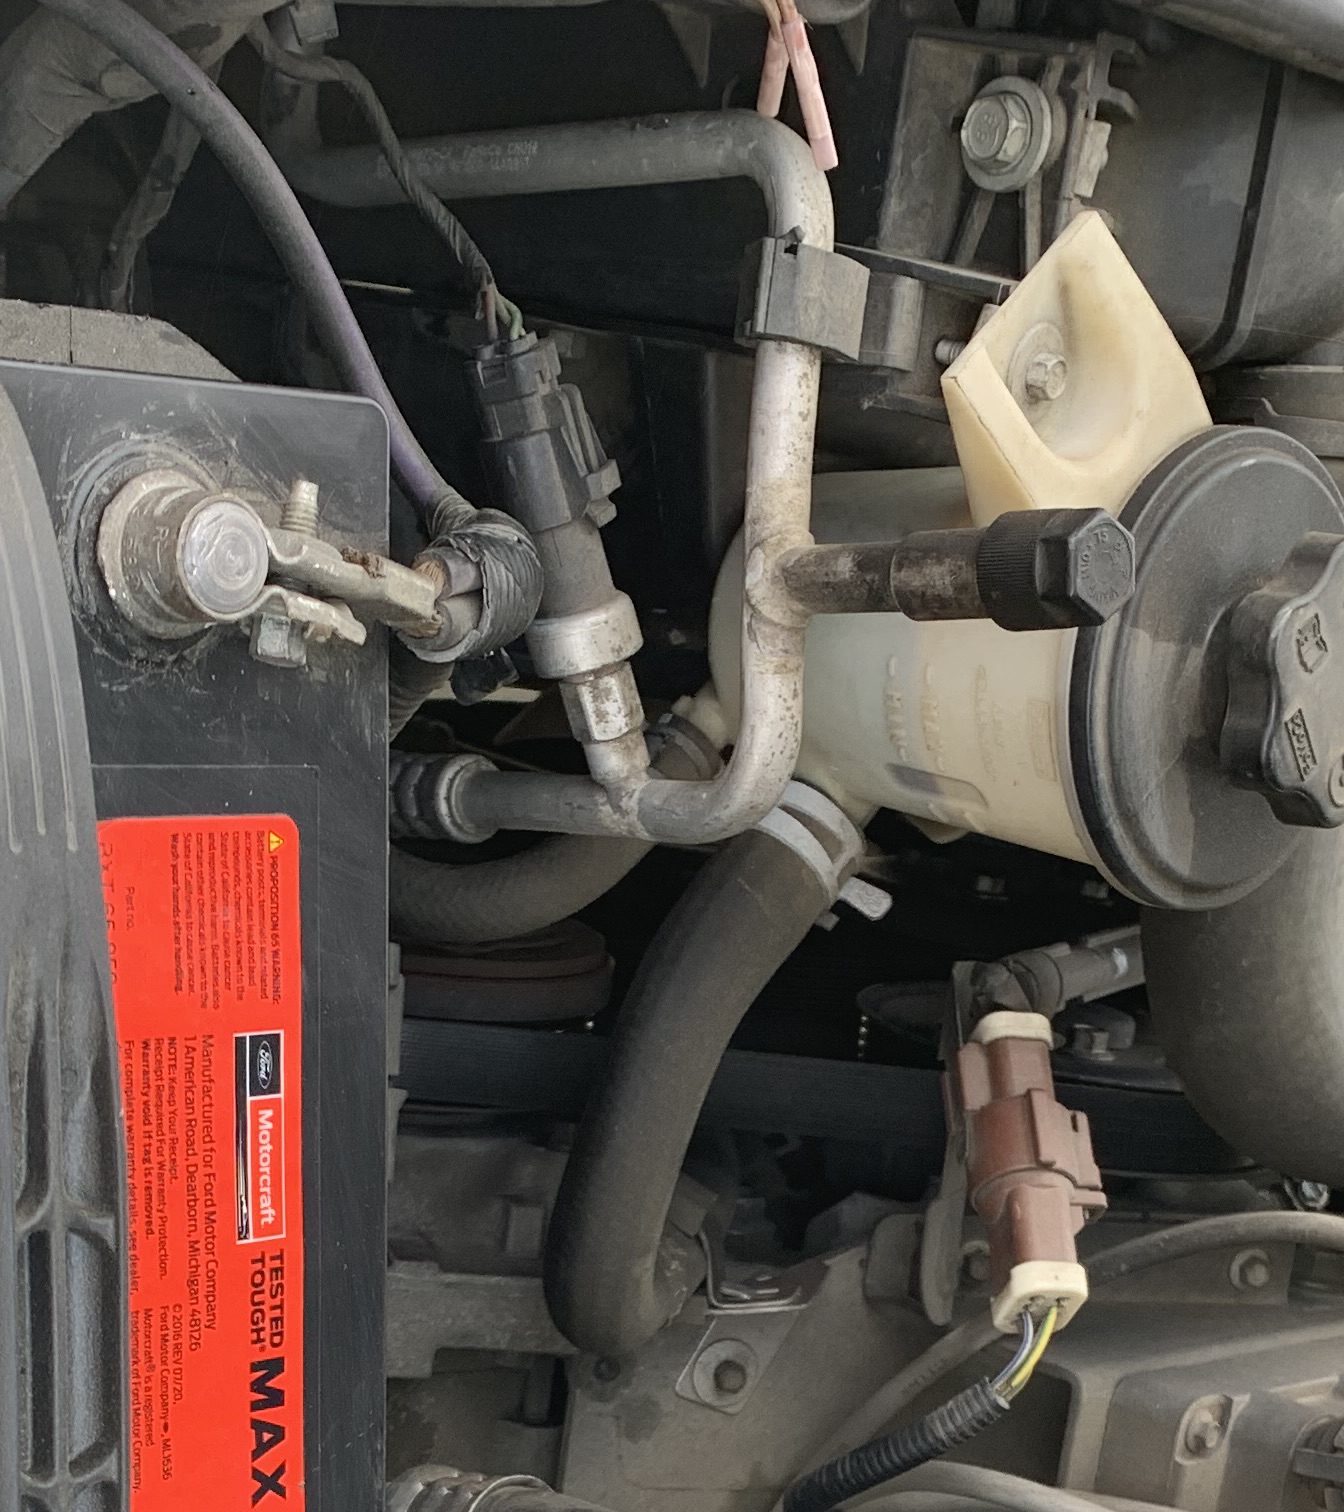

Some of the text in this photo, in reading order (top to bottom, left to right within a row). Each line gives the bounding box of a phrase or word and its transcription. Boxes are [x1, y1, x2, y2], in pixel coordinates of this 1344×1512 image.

[125, 886, 136, 932] Part no.
[269, 855, 282, 1005] PROPOSITION 65 WARNING:
[124, 1040, 136, 1062] For
[122, 1064, 136, 1122] complete
[166, 1036, 180, 1184] NOTE: Keep Your Receipt.
[124, 1124, 137, 1182] warranty
[140, 1038, 156, 1240] Warranty void if tag is removed.
[152, 1037, 170, 1280] Receipt Required For Warranty Protection.
[184, 1034, 202, 1352] 1 American Road, Dearborn, Michigan 48126
[201, 1034, 220, 1330] Manufactured for Ford Motor Company
[258, 1109, 276, 1226] Motorcraft
[128, 1230, 138, 1252] see
[128, 1254, 140, 1296] dealer,
[269, 1248, 285, 1349] TESTED
[160, 1306, 170, 1332] Ford
[172, 1314, 183, 1341] 2016
[160, 1333, 170, 1366] Motor
[172, 1342, 183, 1365] REV
[130, 1310, 143, 1494] trademark of Ford Motor Company.
[144, 1374, 154, 1384] is
[144, 1385, 152, 1393] a
[158, 1368, 170, 1422] Company
[144, 1394, 155, 1447] registered
[249, 1356, 286, 1510] MAX
